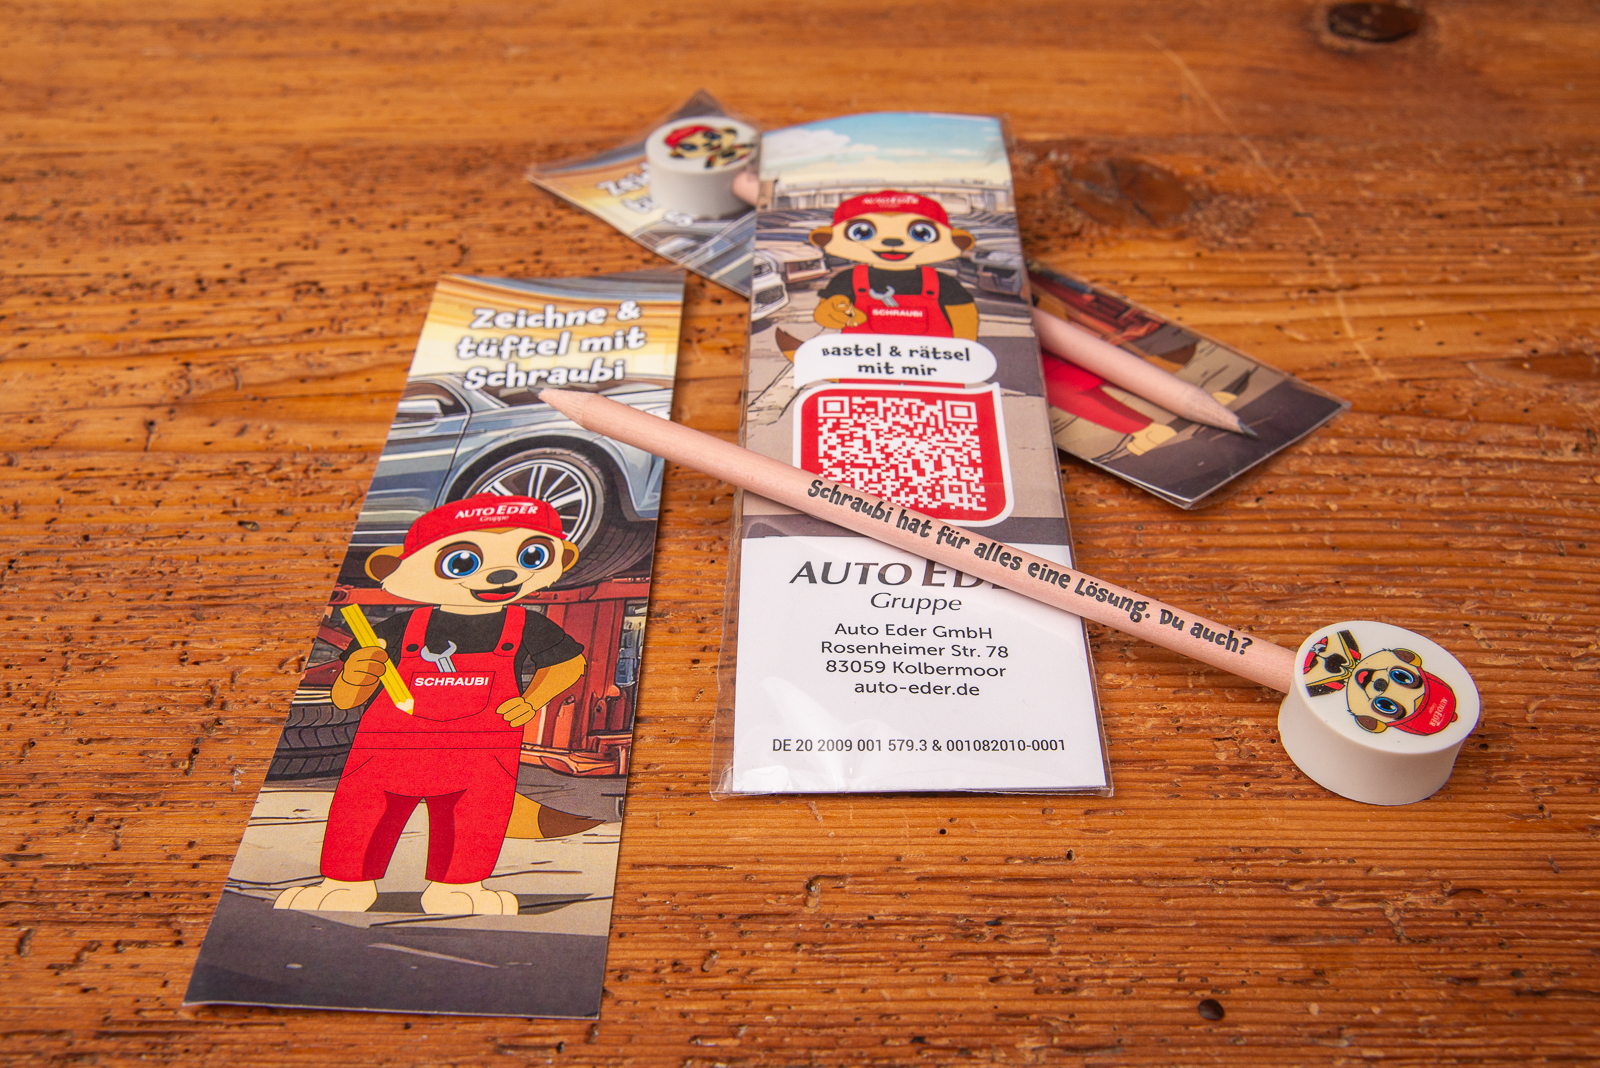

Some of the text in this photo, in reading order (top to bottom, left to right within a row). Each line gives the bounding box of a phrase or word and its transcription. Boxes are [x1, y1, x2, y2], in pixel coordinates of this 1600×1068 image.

[469, 300, 642, 330] Zeichne &
[872, 308, 923, 318] SCHRAUBI
[456, 326, 648, 361] tüftel mit
[889, 346, 902, 357] &
[909, 346, 971, 362] rätsel
[462, 357, 625, 390] Schraubi
[858, 362, 937, 377] mit mir
[454, 505, 539, 519] AUTO EDER
[788, 559, 1007, 589] AUTO ED
[807, 479, 1254, 656] Schraubi hat für alles eine Lösung. Du auch?
[870, 592, 962, 615] Gruppe
[834, 623, 993, 640] Auto Eder GmbH
[821, 641, 1009, 659] Rosenheimer Str. 78
[825, 660, 1007, 677] 83059 Kolbermoor
[414, 677, 489, 687] SCHRAUBI
[854, 681, 980, 696] auto-eder.de
[772, 739, 1066, 752] DE 20 2009 001 579.3 & 001082010-0001
